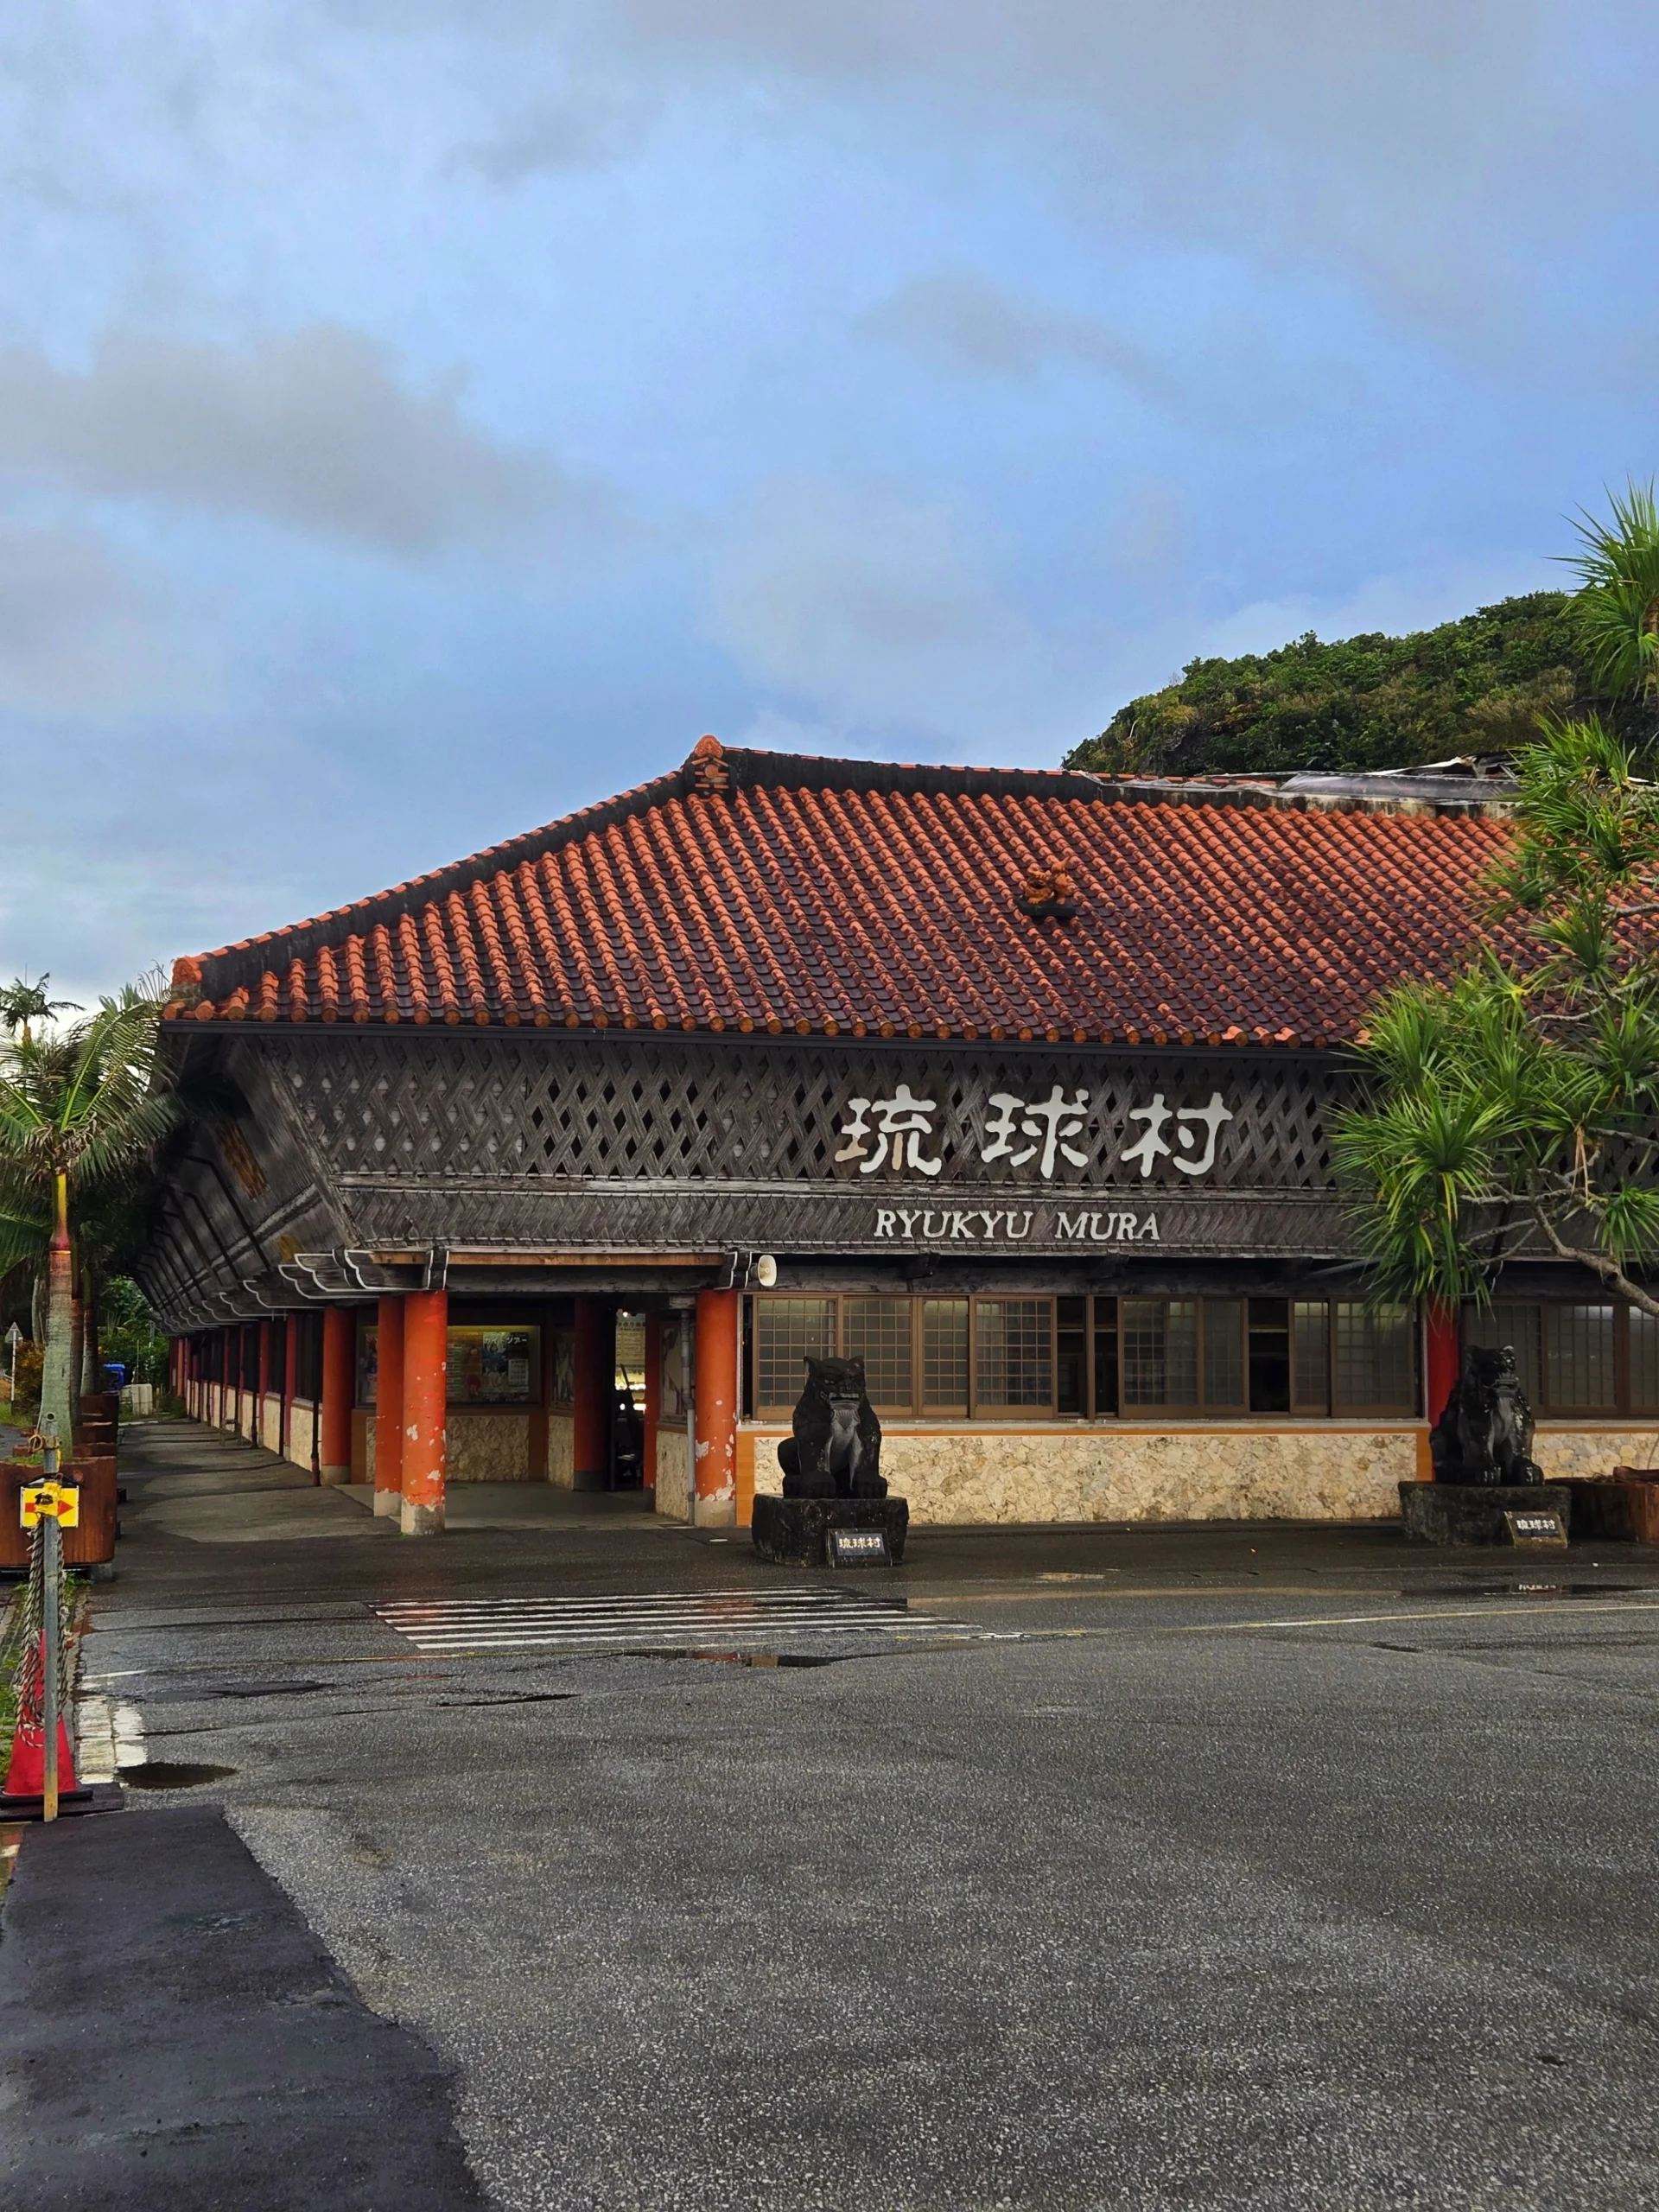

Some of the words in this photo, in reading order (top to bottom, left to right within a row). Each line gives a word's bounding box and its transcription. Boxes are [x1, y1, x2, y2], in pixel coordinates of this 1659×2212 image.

[835, 1084, 1233, 1179] 琉球村
[874, 1209, 1034, 1239] RYUKYU
[1054, 1211, 1160, 1240] MURA
[839, 1537, 880, 1549] 琉球村
